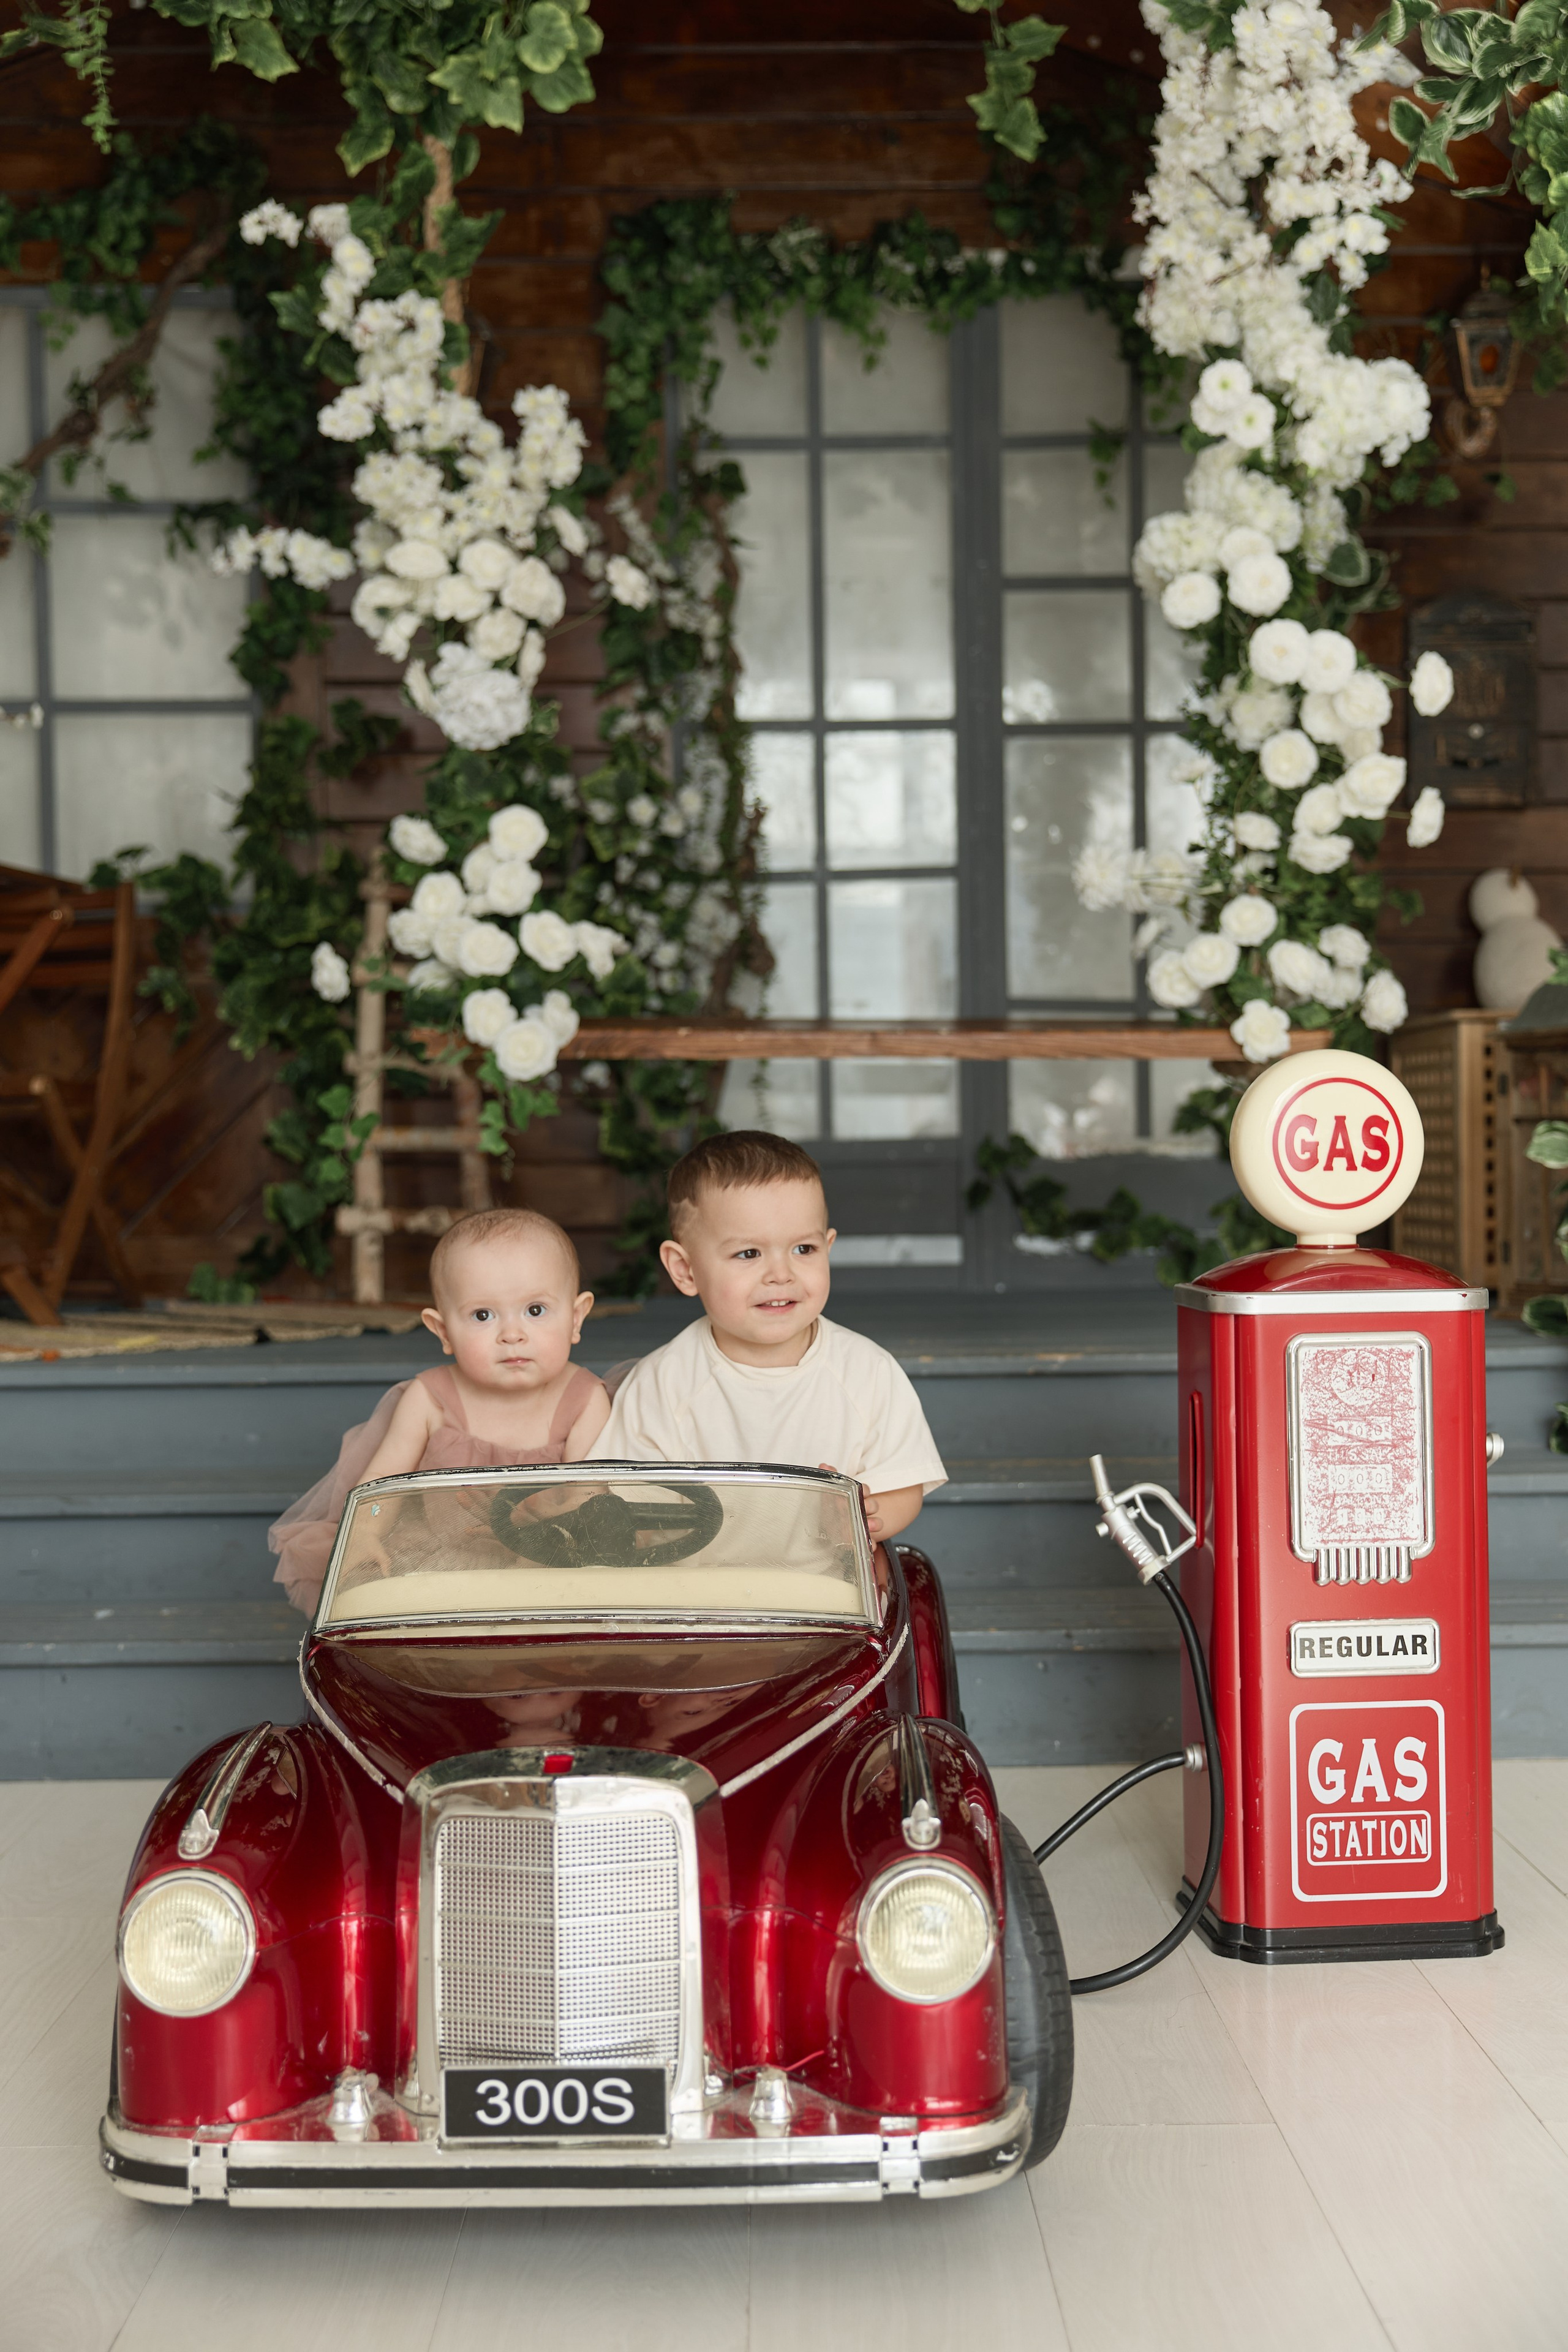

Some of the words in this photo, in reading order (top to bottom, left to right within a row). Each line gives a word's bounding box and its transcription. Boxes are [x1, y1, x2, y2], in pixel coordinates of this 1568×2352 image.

[1284, 1114, 1390, 1172] GAS
[1298, 1634, 1428, 1659] REGULAR
[1308, 1736, 1428, 1804] GAS
[1313, 1819, 1427, 1858] STATION
[475, 2078, 635, 2126] 300S
